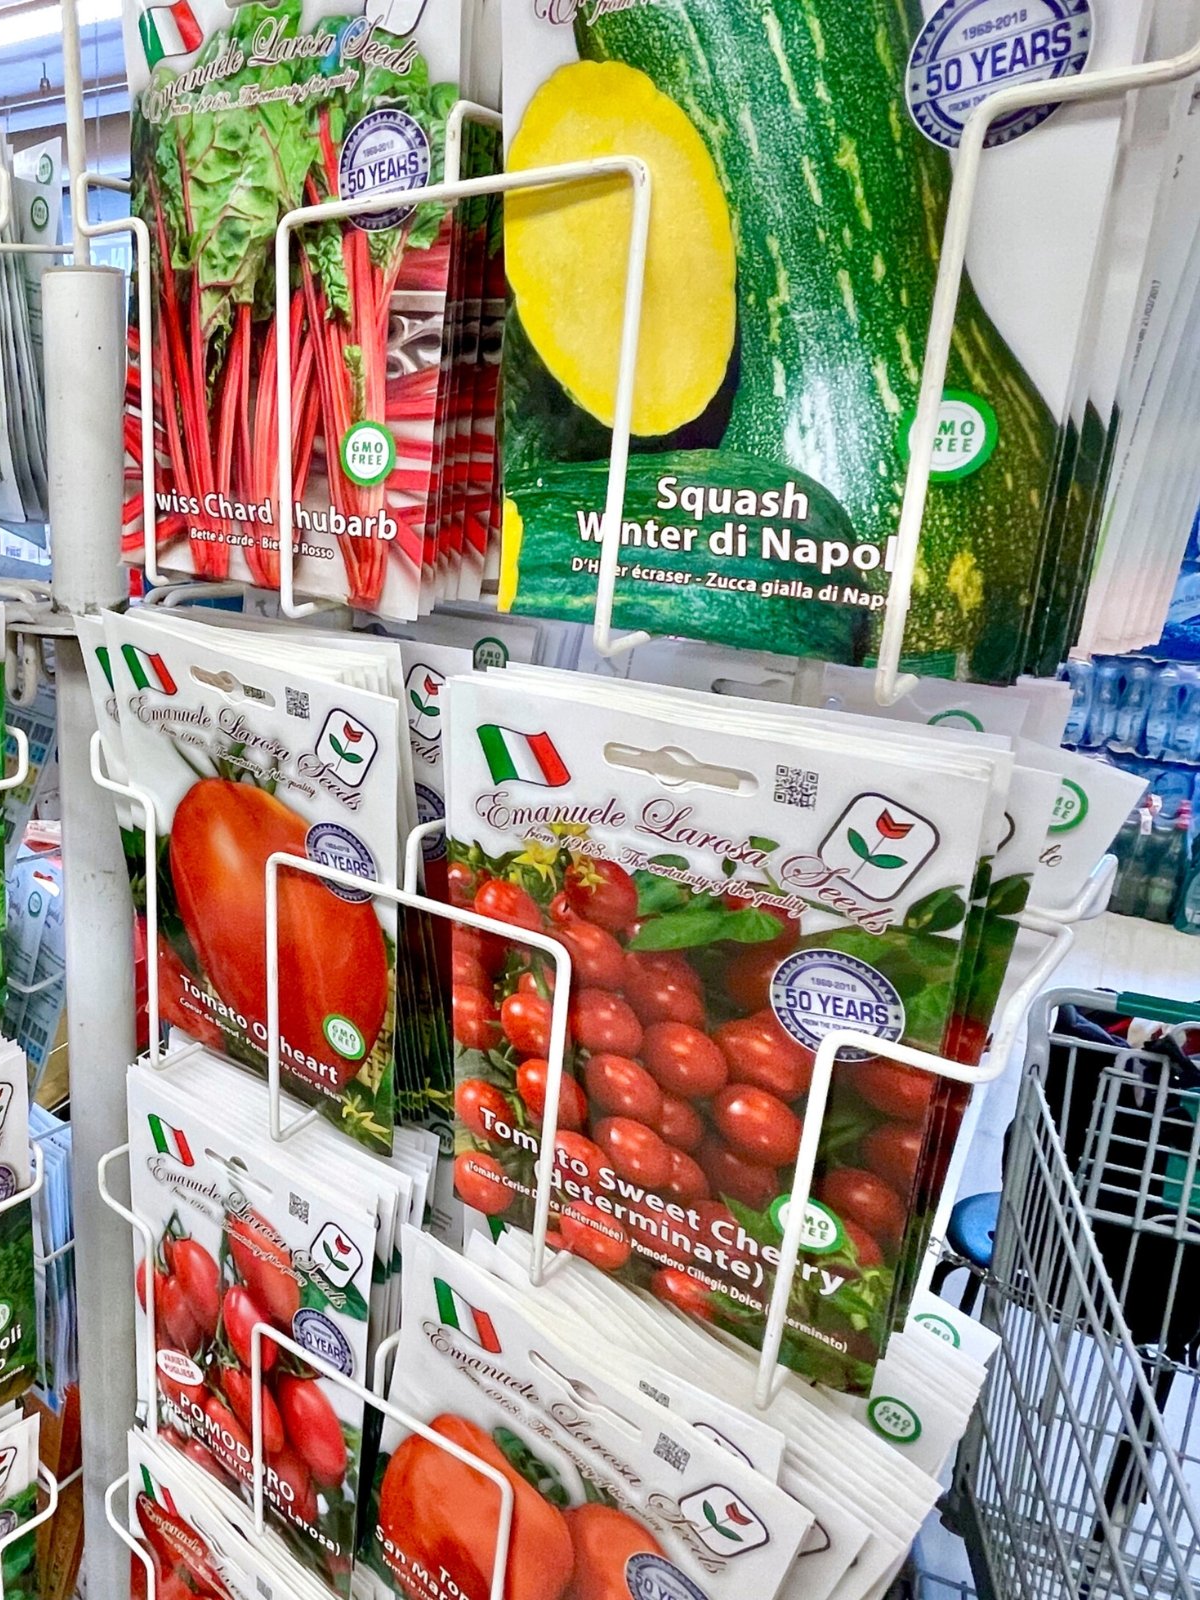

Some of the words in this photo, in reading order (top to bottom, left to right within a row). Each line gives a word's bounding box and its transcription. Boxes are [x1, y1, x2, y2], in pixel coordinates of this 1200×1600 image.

[247, 15, 336, 66] Larosa
[339, 15, 420, 75] Seeds
[926, 58, 963, 98] 50
[970, 21, 1073, 82] YEARS
[348, 170, 366, 193] 50
[368, 151, 420, 189] YEARS
[351, 441, 383, 455] GMO
[938, 418, 977, 437] MO
[351, 453, 383, 467] FREE
[155, 489, 199, 516] wiss
[204, 492, 273, 526] Chard
[282, 501, 399, 542] hubarb
[656, 476, 809, 520] Squash
[190, 526, 218, 542] Bette
[226, 532, 255, 548] carde
[301, 542, 335, 560] Rosso
[575, 510, 698, 552] Wnter
[708, 522, 748, 558] di
[760, 526, 899, 574] Napol
[631, 563, 693, 585] écraser
[704, 572, 758, 593] Zucca
[761, 578, 814, 600] gialla
[818, 584, 839, 603] di
[128, 695, 212, 729] Emanuele
[217, 706, 292, 763] Larosa
[296, 752, 365, 812] Seeds
[328, 853, 370, 878] YEARS
[475, 791, 626, 829] Emanuele
[634, 798, 770, 869] Larosa
[780, 855, 899, 935] Seeds
[520, 826, 556, 845] from
[647, 862, 712, 894] certainty
[751, 888, 809, 918] quality
[786, 988, 812, 1010] 50
[818, 994, 889, 1027] YEARS
[179, 974, 248, 1030] Tomato
[252, 1021, 339, 1085] Oheart
[331, 1031, 357, 1051] FREE
[332, 1023, 357, 1043] GMO
[146, 1154, 222, 1202] Emanuele
[479, 1105, 589, 1177] Tomto
[598, 1167, 701, 1232] Sweet
[710, 1220, 846, 1297] Chery
[467, 1159, 501, 1184] Tomate
[501, 1174, 532, 1196] Cerise
[630, 1238, 685, 1273] Pomodoro
[729, 1286, 763, 1312] Dolce
[803, 1214, 830, 1231] MO
[314, 1333, 349, 1365] YEARS
[923, 1321, 951, 1342] GMO
[421, 1319, 541, 1403] Emanuele
[545, 1402, 642, 1488] Larosa
[882, 1405, 912, 1429] GMO
[288, 1507, 341, 1556] Larosa)
[375, 1524, 408, 1565] San
